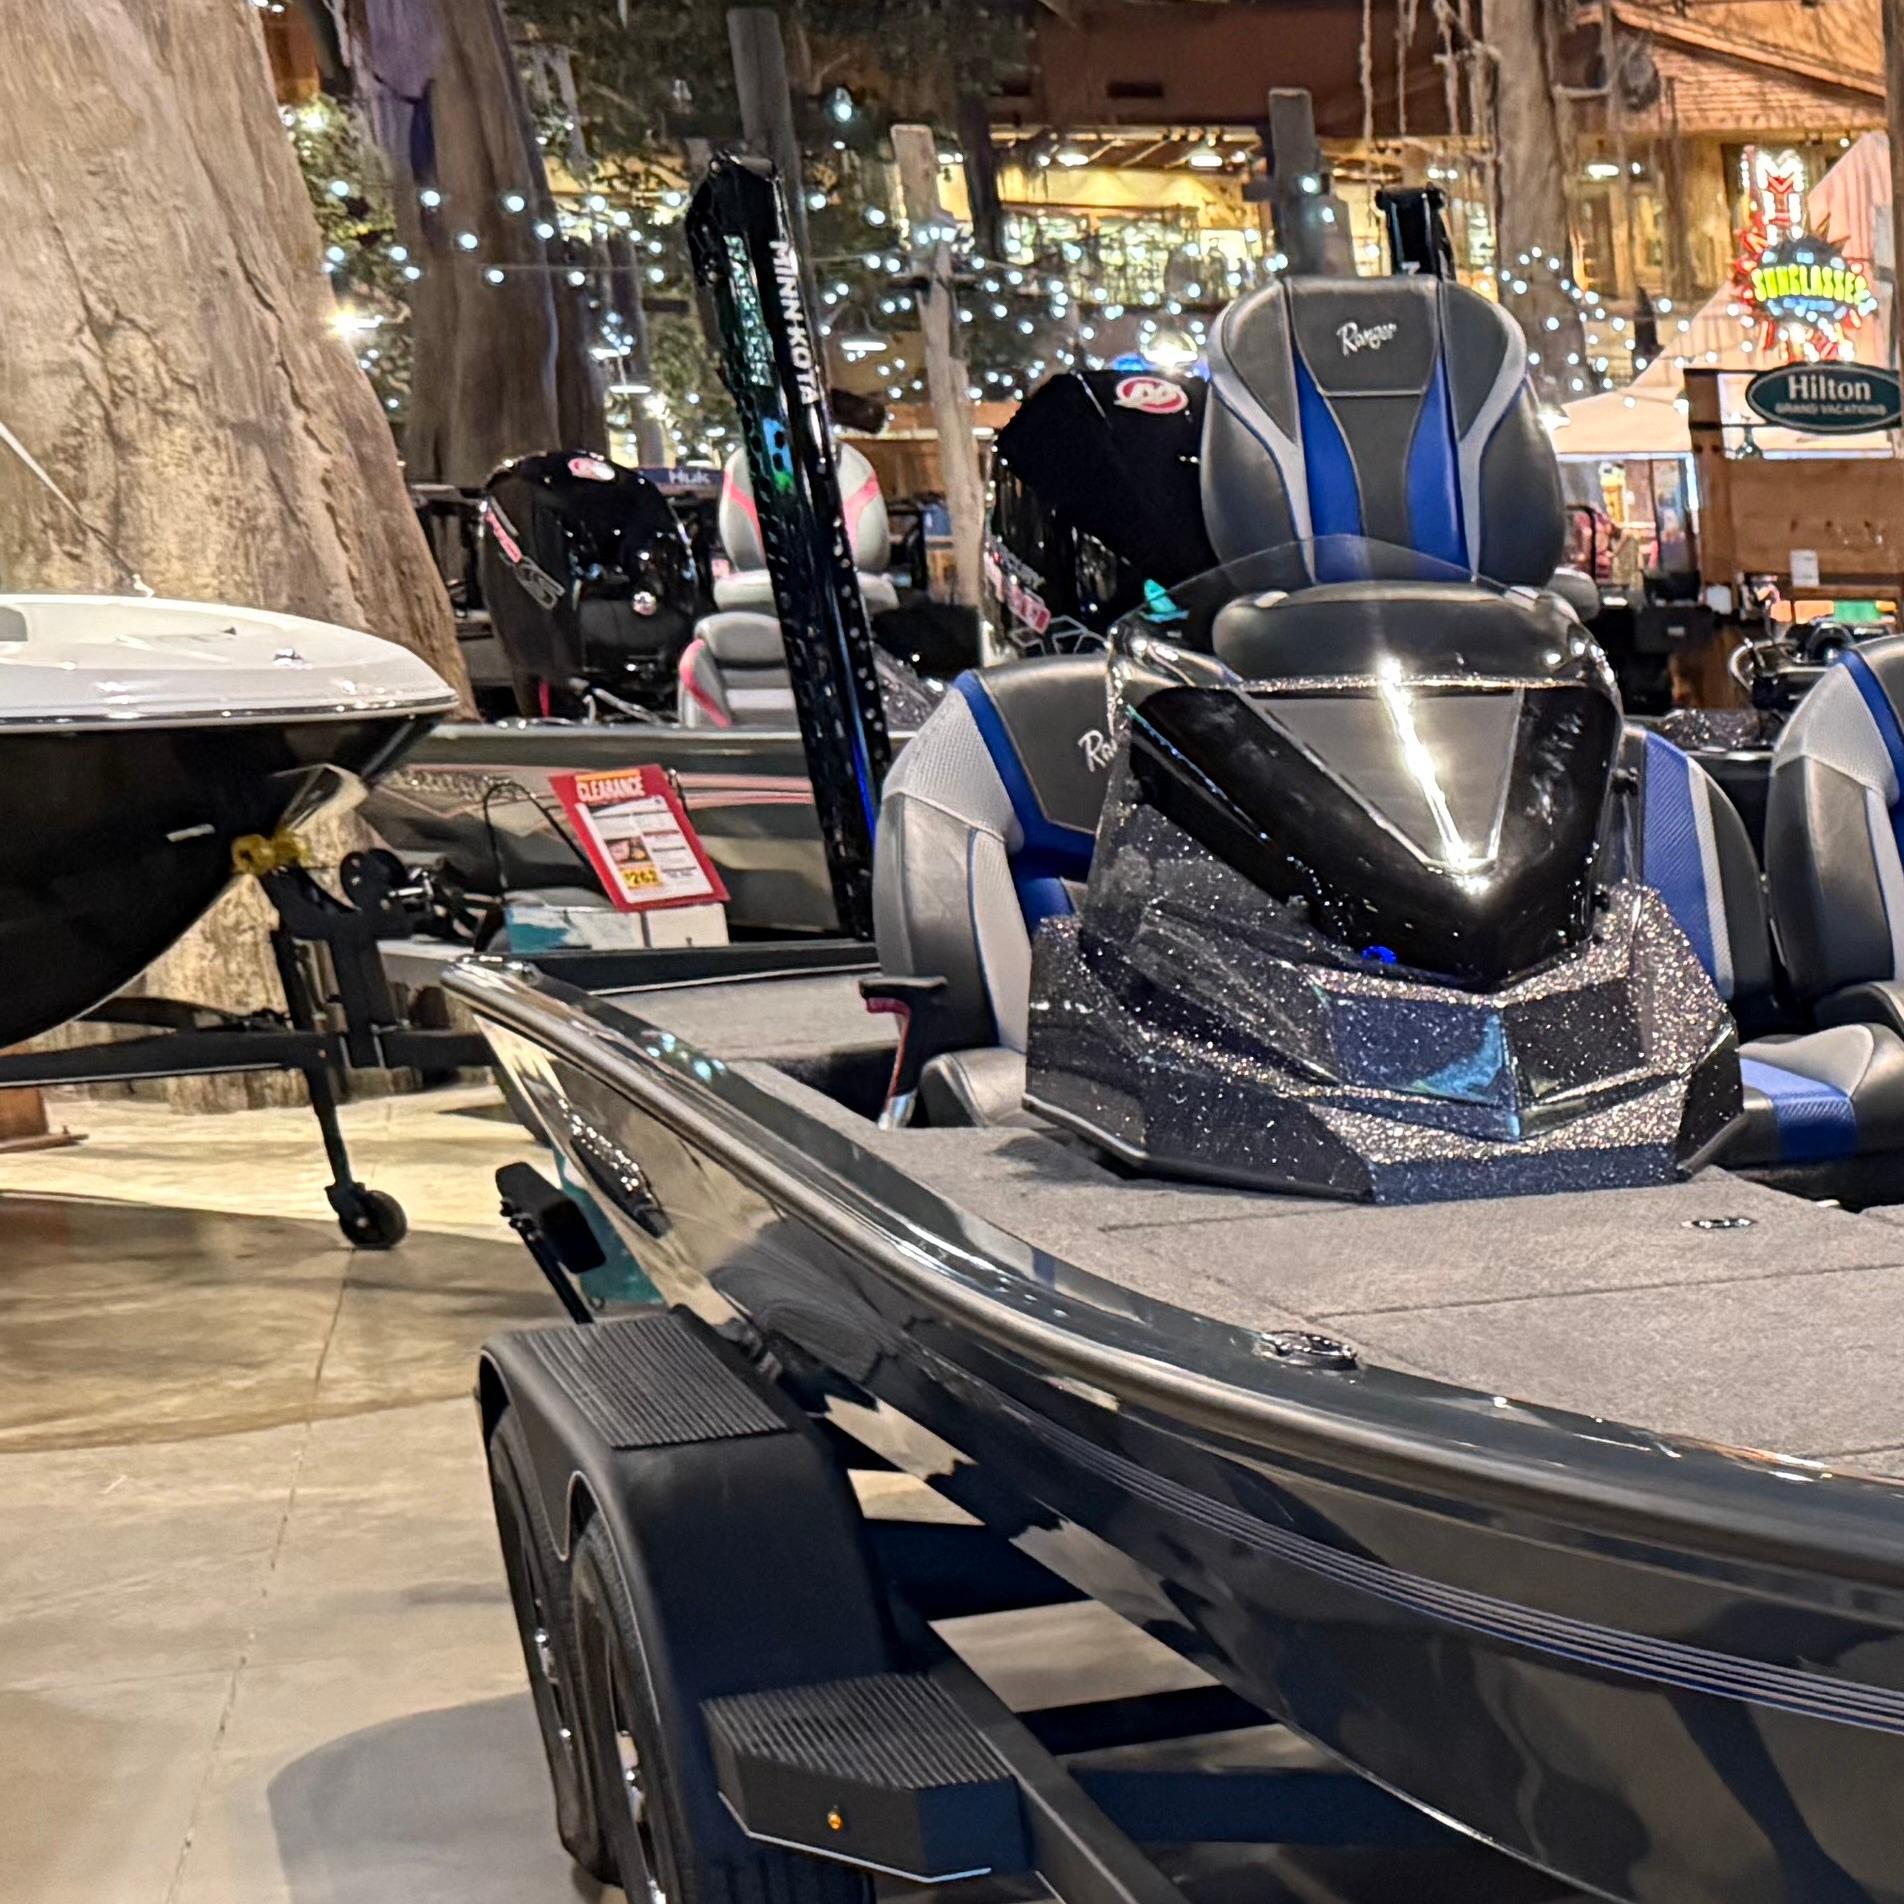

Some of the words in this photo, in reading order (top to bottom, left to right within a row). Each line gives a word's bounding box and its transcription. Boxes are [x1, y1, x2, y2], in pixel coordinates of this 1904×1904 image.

[769, 238, 805, 322] MINN
[786, 325, 821, 405] KOTA
[1336, 321, 1397, 357] Ranger
[1787, 374, 1872, 401] Hilton
